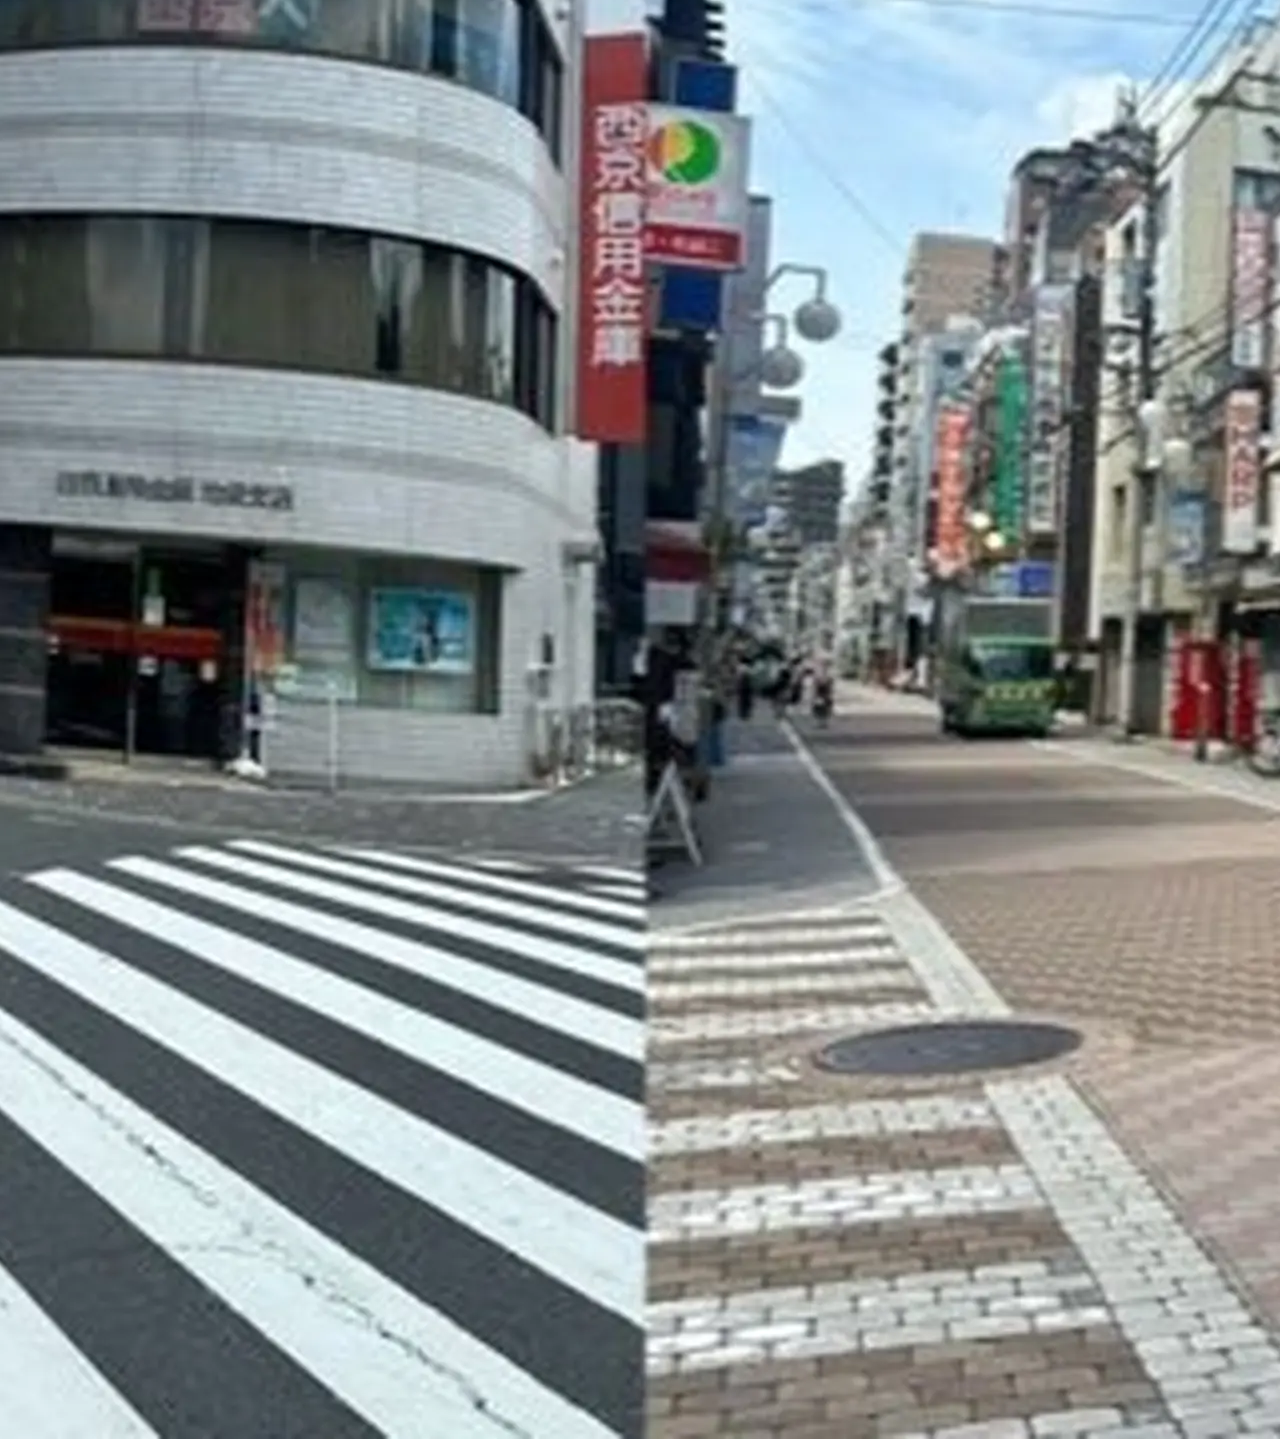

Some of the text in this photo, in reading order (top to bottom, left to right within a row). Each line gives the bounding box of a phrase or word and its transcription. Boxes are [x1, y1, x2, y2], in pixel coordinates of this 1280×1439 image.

[592, 102, 648, 369] 西京信用金庫
